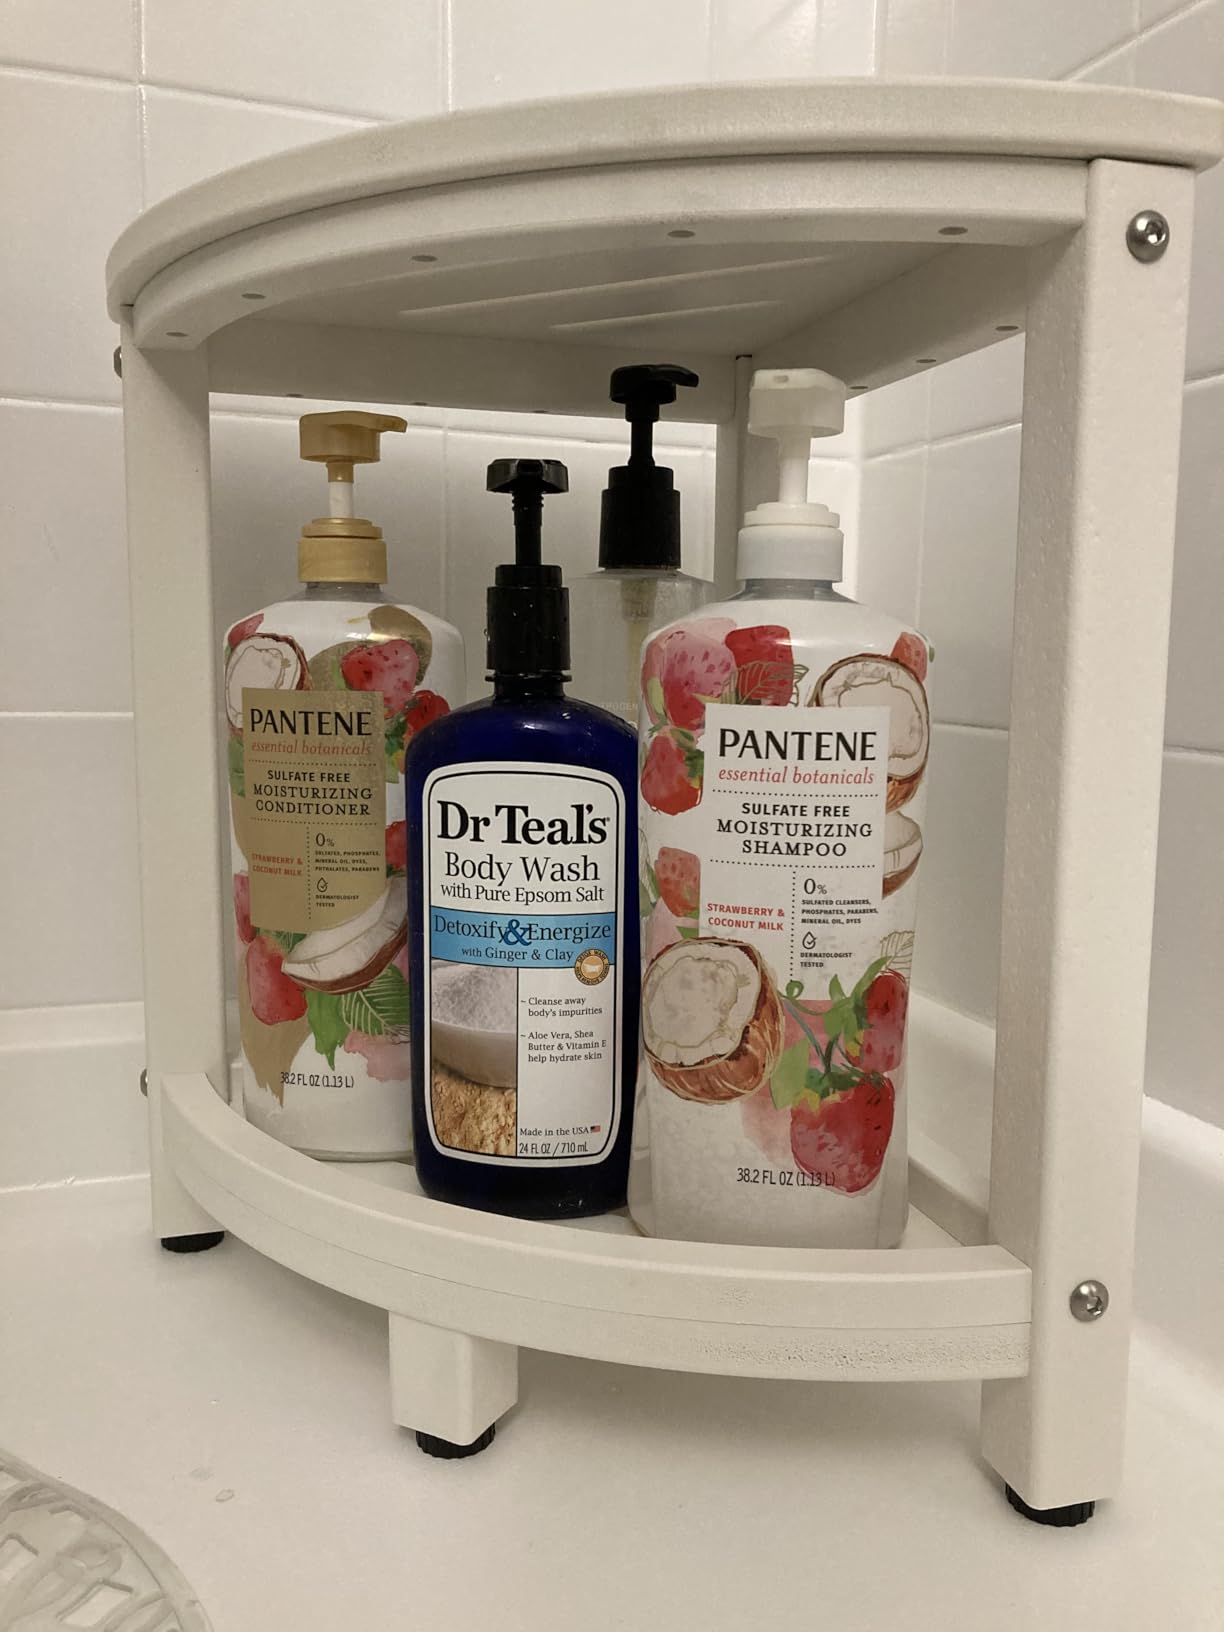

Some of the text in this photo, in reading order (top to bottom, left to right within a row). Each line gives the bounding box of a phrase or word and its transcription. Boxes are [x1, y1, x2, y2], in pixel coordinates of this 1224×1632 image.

[251, 709, 372, 735] PANTENE
[252, 740, 370, 756] essential botanicals
[719, 728, 877, 761] PANTENE
[268, 770, 350, 782] SULFATE FREE
[719, 766, 874, 784] essential botanicals
[254, 784, 372, 800] MOISTURIZING
[256, 800, 370, 815] CONDITIONER
[742, 803, 850, 817] SULFATE FREE
[437, 800, 607, 845] Dr Teal's
[717, 819, 872, 837] MOISTURIZING
[316, 833, 335, 847] 0%
[742, 840, 847, 857] SHAMPOO
[252, 853, 294, 865] STRAWBERRY
[253, 865, 302, 876] COCONUT MILK
[445, 851, 600, 886] Body Wash
[440, 883, 604, 905] with Pure Epsom Salt
[804, 878, 827, 895] 0%
[707, 903, 785, 917] STRAWBERRY &
[434, 915, 611, 946] Detoxify & Energize
[708, 917, 784, 930] COCONUT MILK
[462, 947, 574, 963] with Ginger & Clay
[528, 997, 586, 1006] Cleanse away
[528, 1007, 603, 1018] body's impurities
[551, 1032, 572, 1040] Vera,
[574, 1030, 594, 1038] Shea
[528, 1043, 555, 1051] Butter
[566, 1041, 599, 1050] Vitamin
[602, 1040, 606, 1048] E
[528, 1052, 602, 1063] help hydrate skin
[280, 1072, 354, 1088] 38.2 FL OZ (1.13 L)
[520, 1128, 542, 1136] Made
[545, 1128, 553, 1136] in
[572, 1127, 589, 1135] USA
[519, 1142, 588, 1157] 24 FL OZ / 710 mL
[737, 1168, 835, 1186] 38.2 FL OZ (1.13 L)
